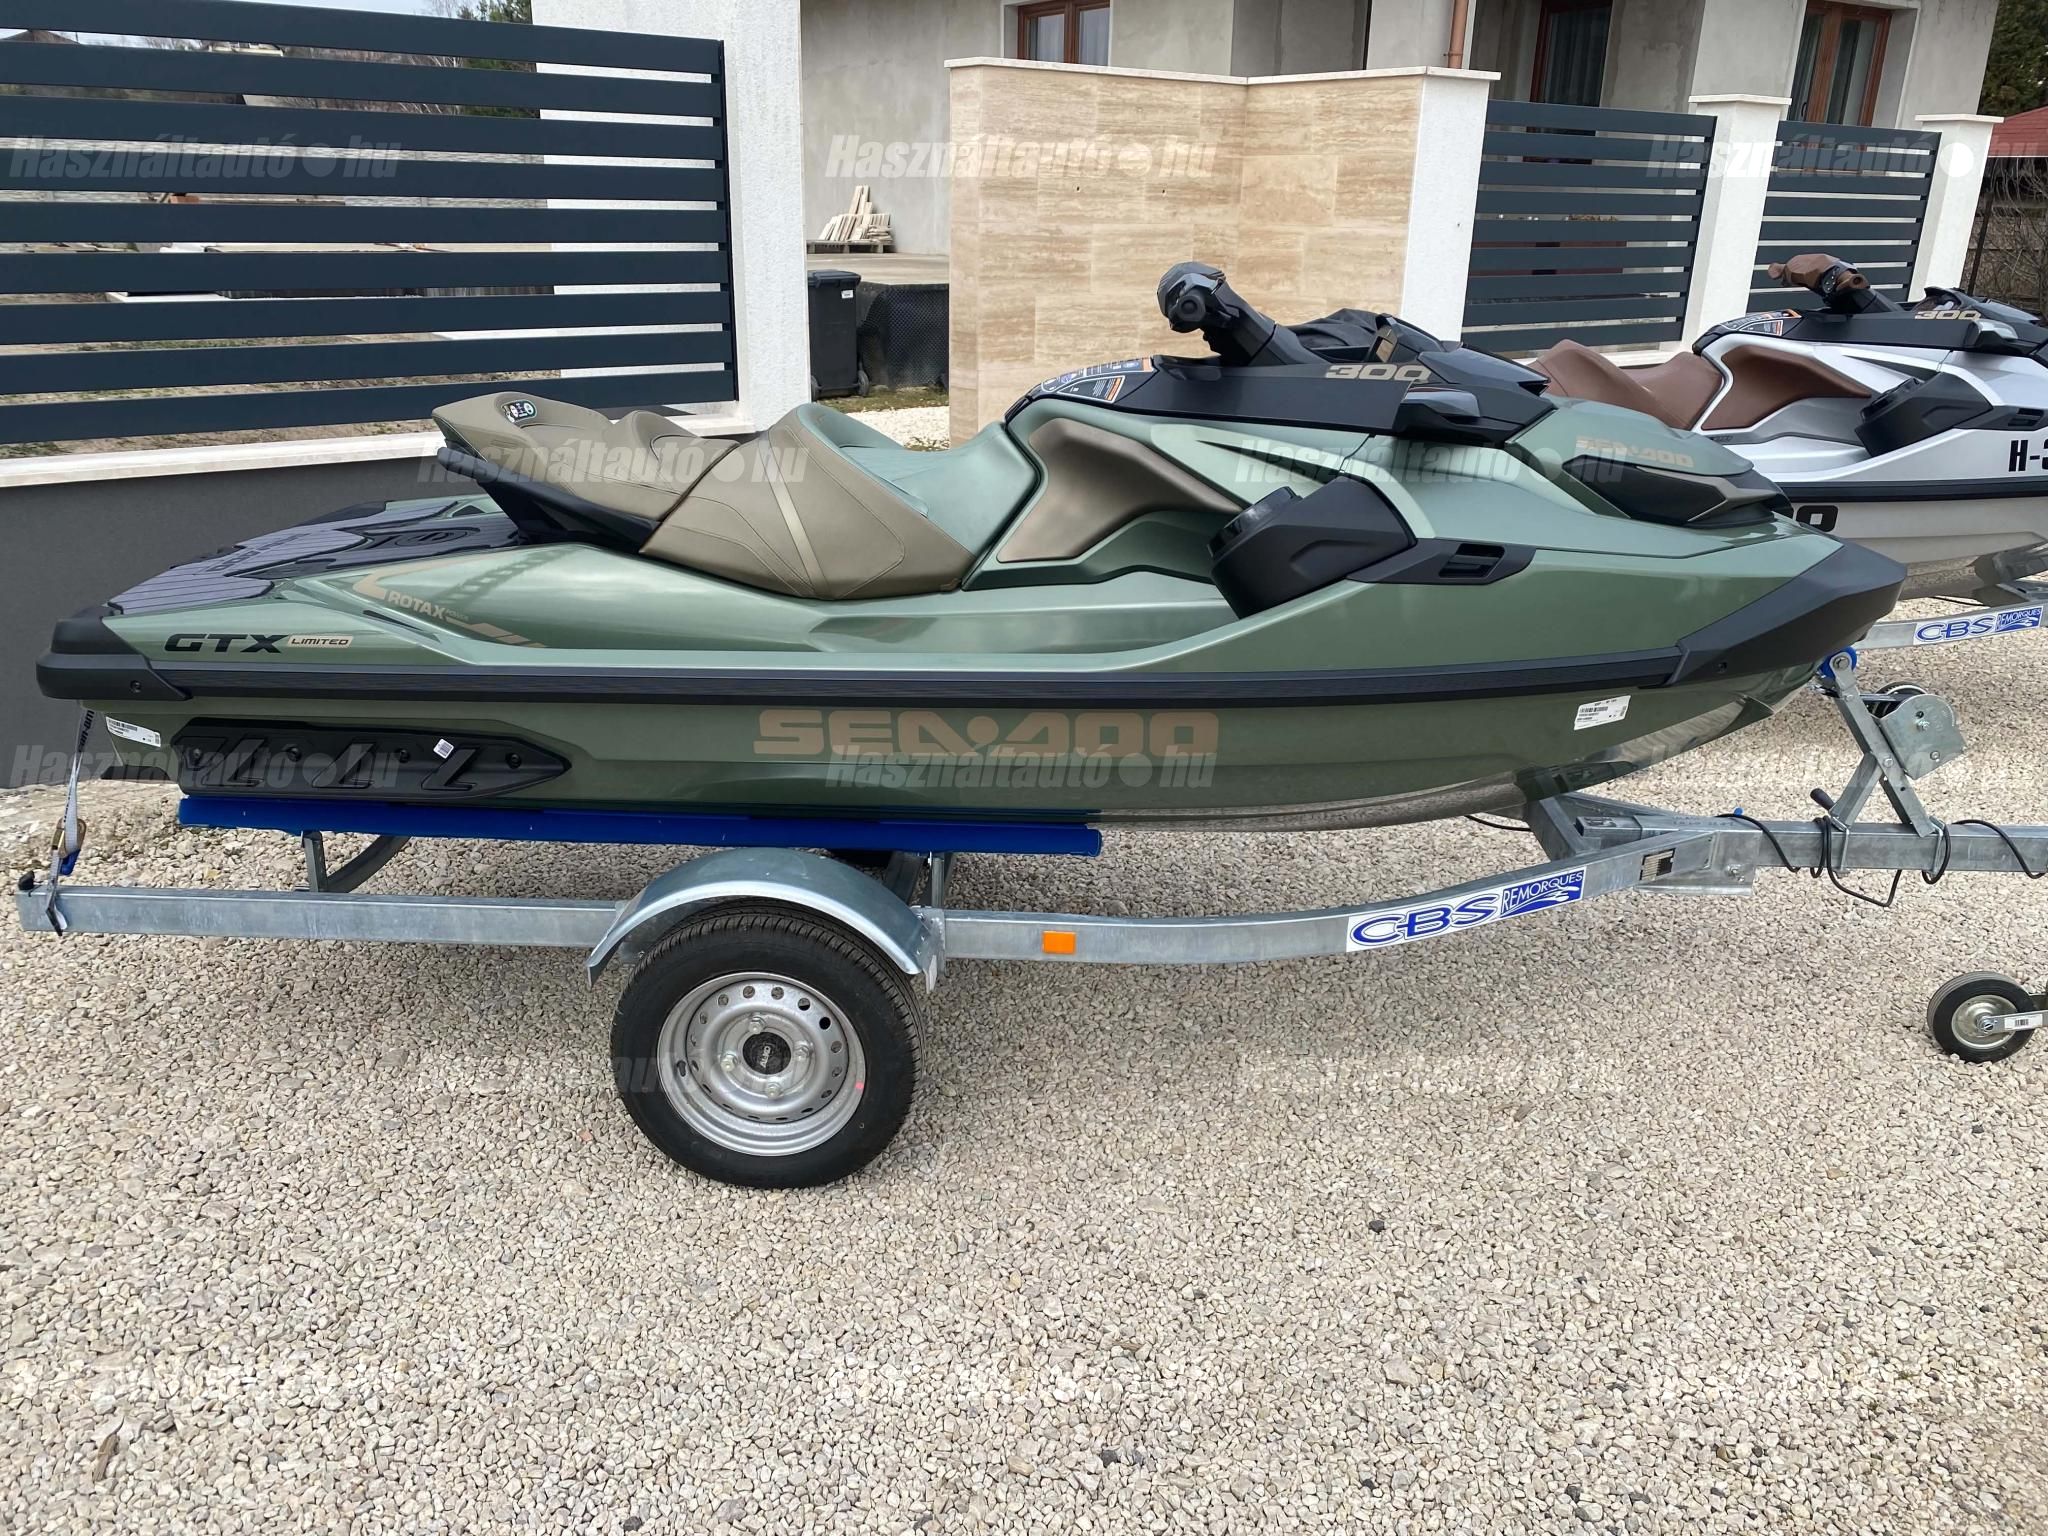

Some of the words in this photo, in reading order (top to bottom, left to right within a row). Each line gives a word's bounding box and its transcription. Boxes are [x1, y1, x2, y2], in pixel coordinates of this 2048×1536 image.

[1914, 309, 1982, 320] 300
[1325, 364, 1432, 384] 300
[388, 590, 446, 619] ROTAX
[164, 633, 289, 653] GTX
[291, 637, 350, 647] LIMITED
[1350, 894, 1501, 946] CBS
[1500, 871, 1584, 915] REMORQUES
